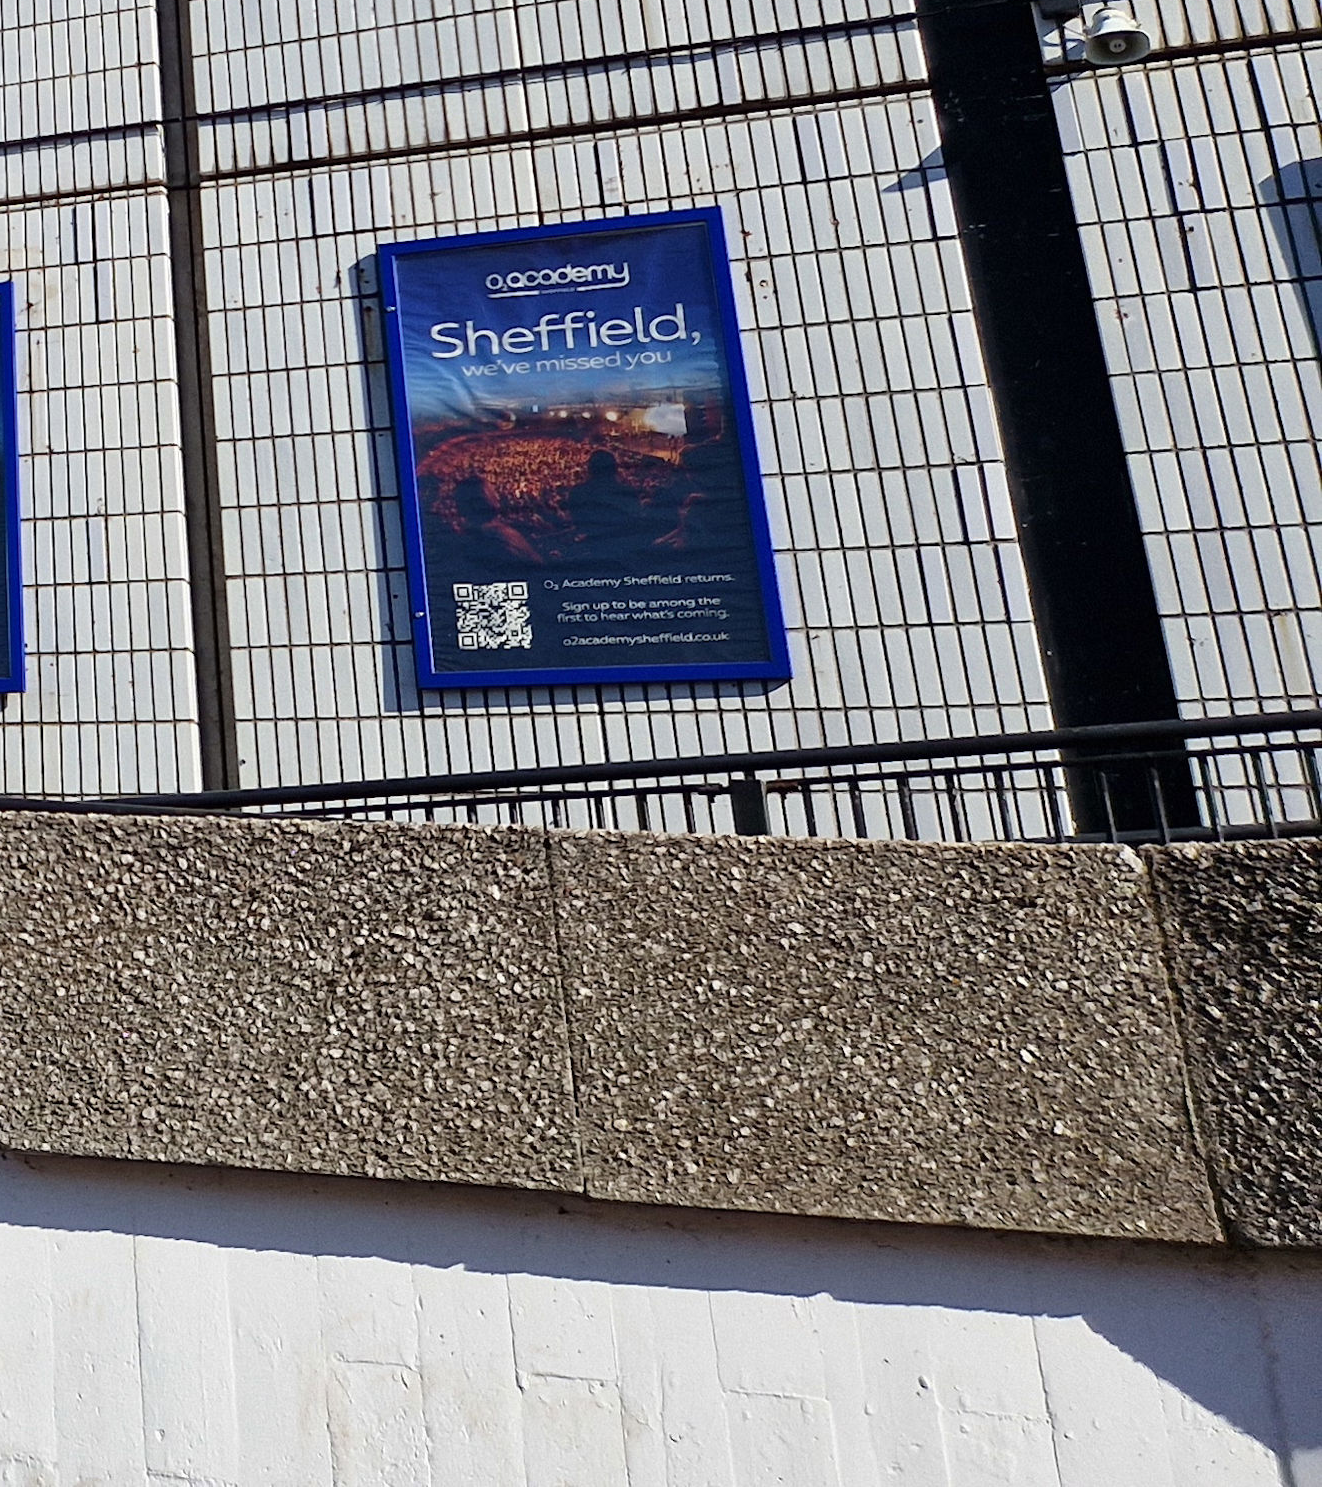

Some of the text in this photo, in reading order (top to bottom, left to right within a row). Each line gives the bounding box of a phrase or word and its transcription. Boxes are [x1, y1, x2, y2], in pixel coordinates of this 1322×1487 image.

[430, 303, 701, 359] Sheffield,
[461, 350, 672, 377] we've missed you
[561, 576, 622, 589] Academy
[623, 574, 682, 586] Sheffield
[683, 573, 736, 584] returns.
[561, 596, 721, 613] Sign up to be among the
[557, 612, 583, 623] first
[583, 612, 599, 622] to
[600, 611, 631, 621] hear
[631, 609, 675, 620] what's
